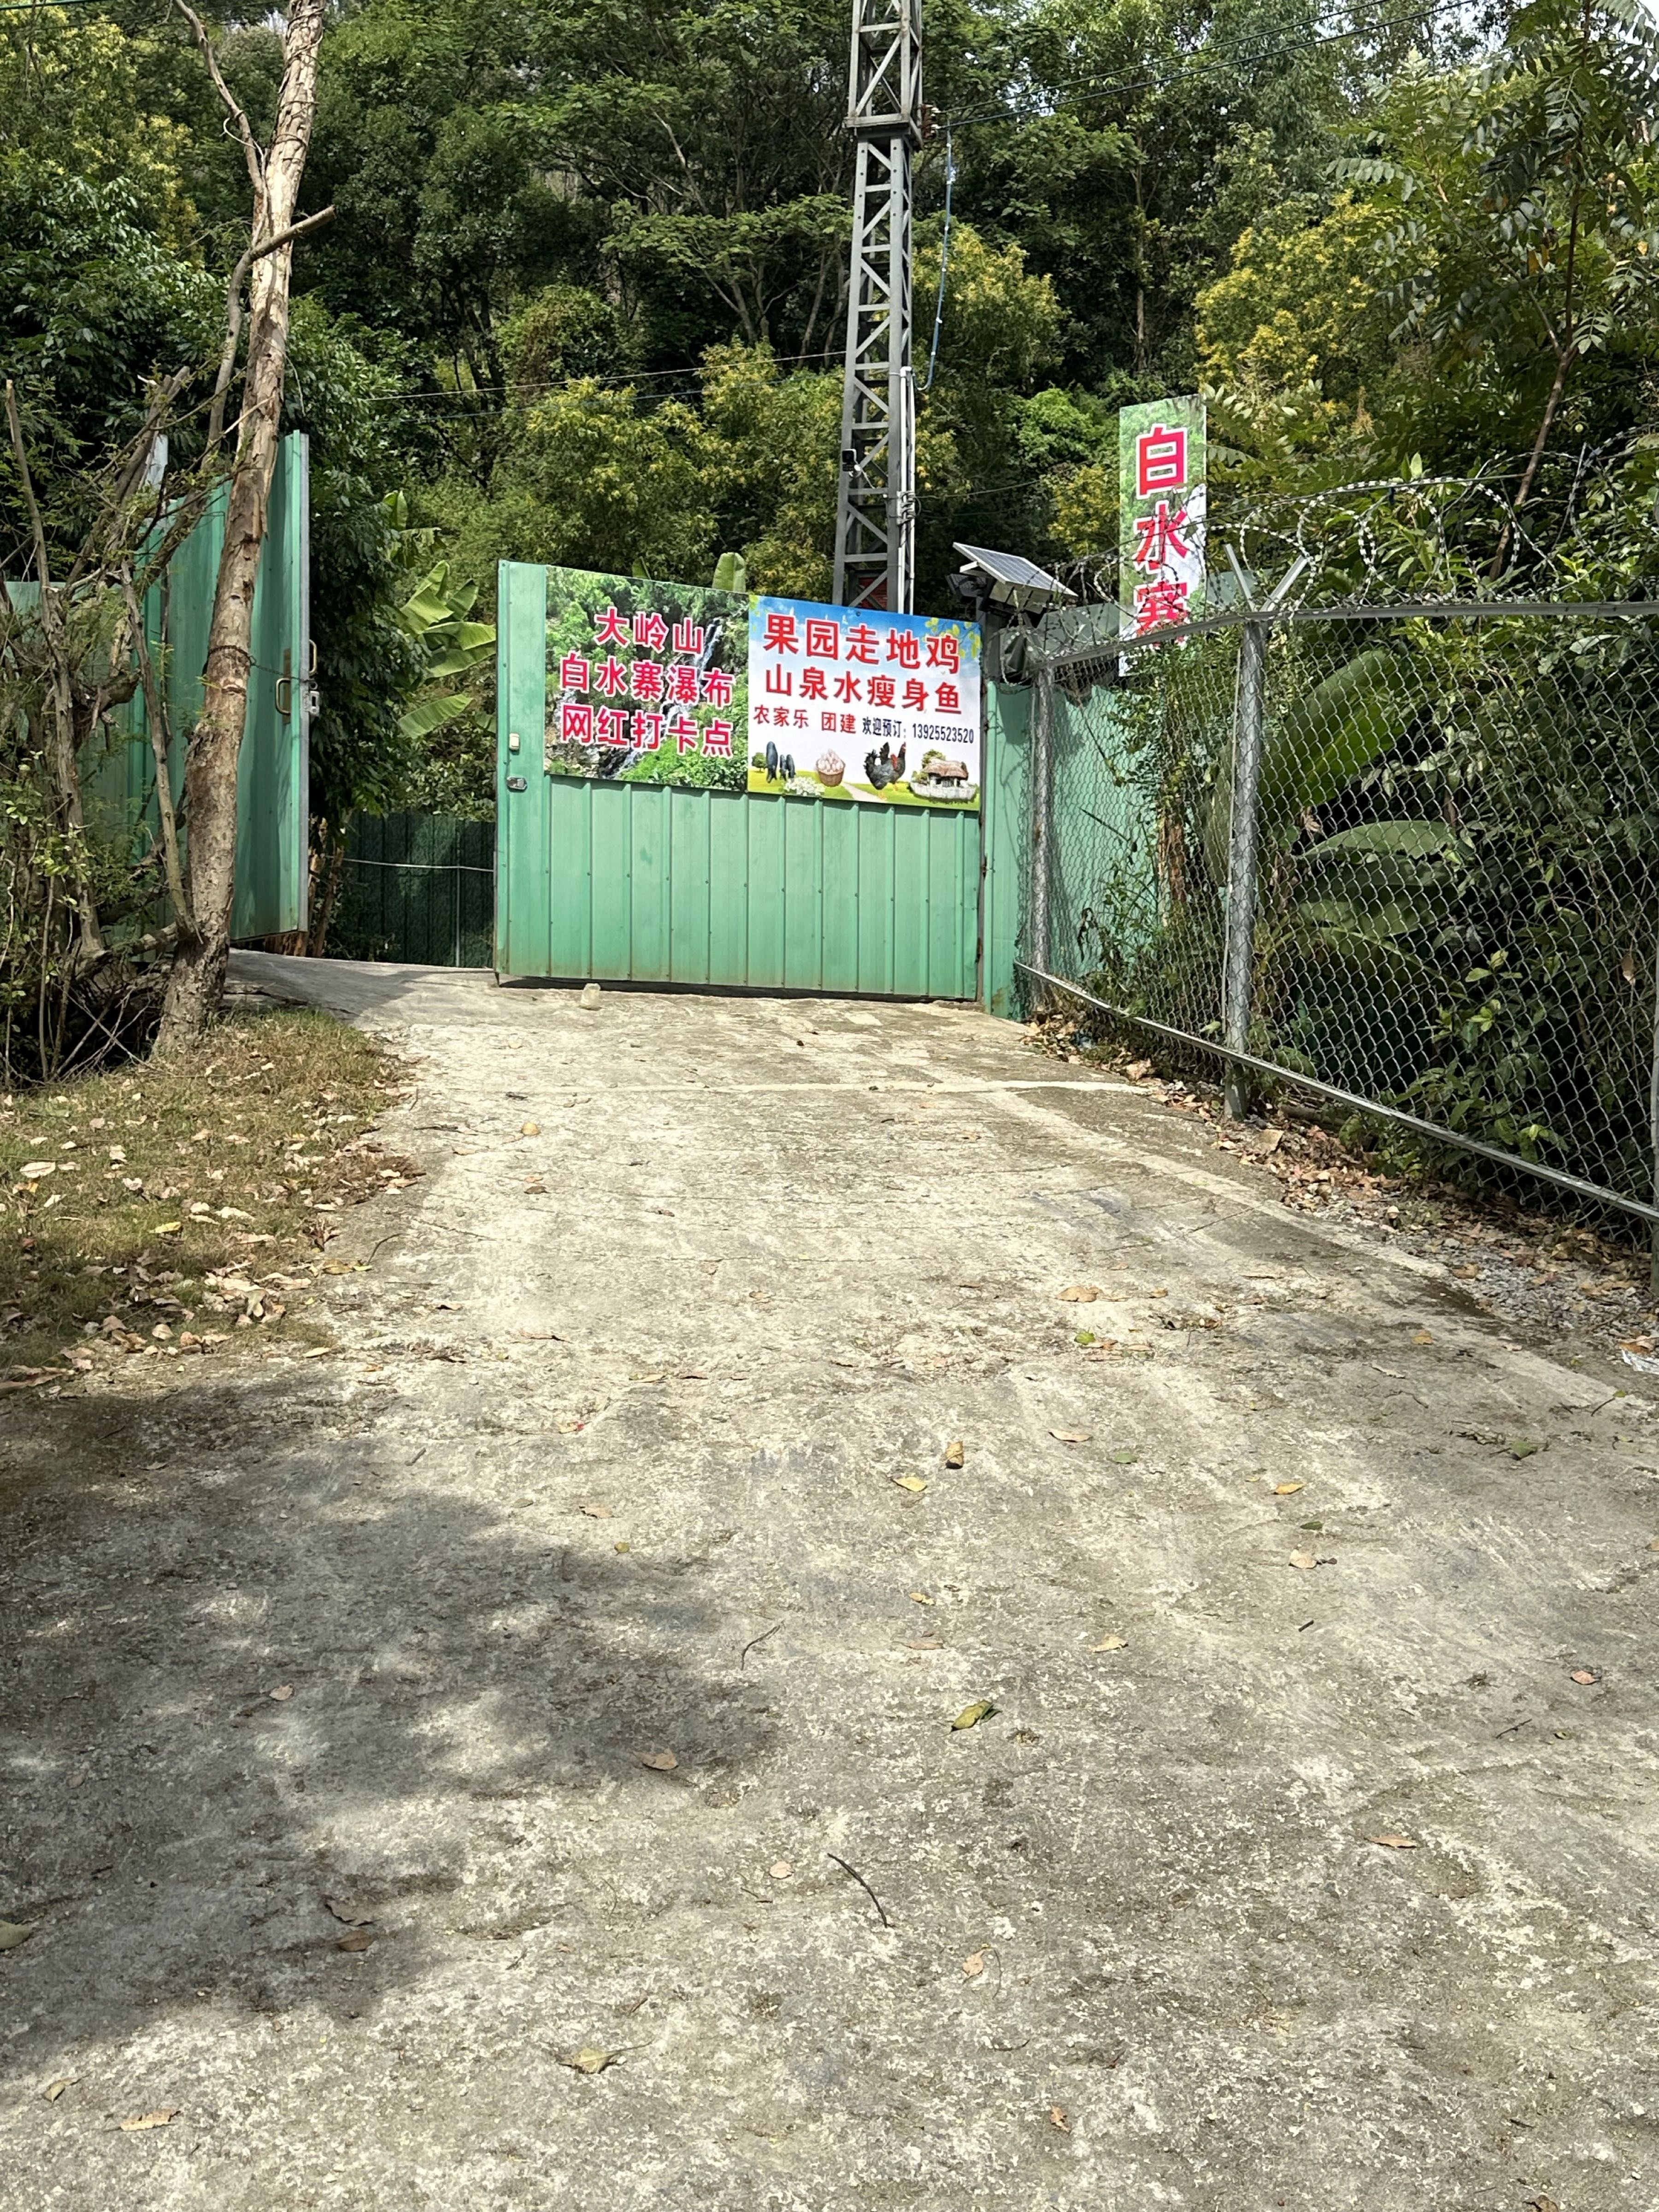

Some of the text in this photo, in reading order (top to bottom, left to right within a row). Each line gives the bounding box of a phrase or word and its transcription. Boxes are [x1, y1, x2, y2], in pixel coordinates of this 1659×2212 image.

[595, 608, 703, 654] 大岭山
[763, 613, 960, 674] 果园走地鸡
[562, 653, 734, 708] 白水寨瀑布
[765, 664, 961, 714] 山泉水瘦身鱼
[562, 705, 734, 757] 网红打卡点
[753, 704, 809, 729] 农家乐
[821, 712, 856, 734] 团建
[912, 723, 974, 744] 13925523520
